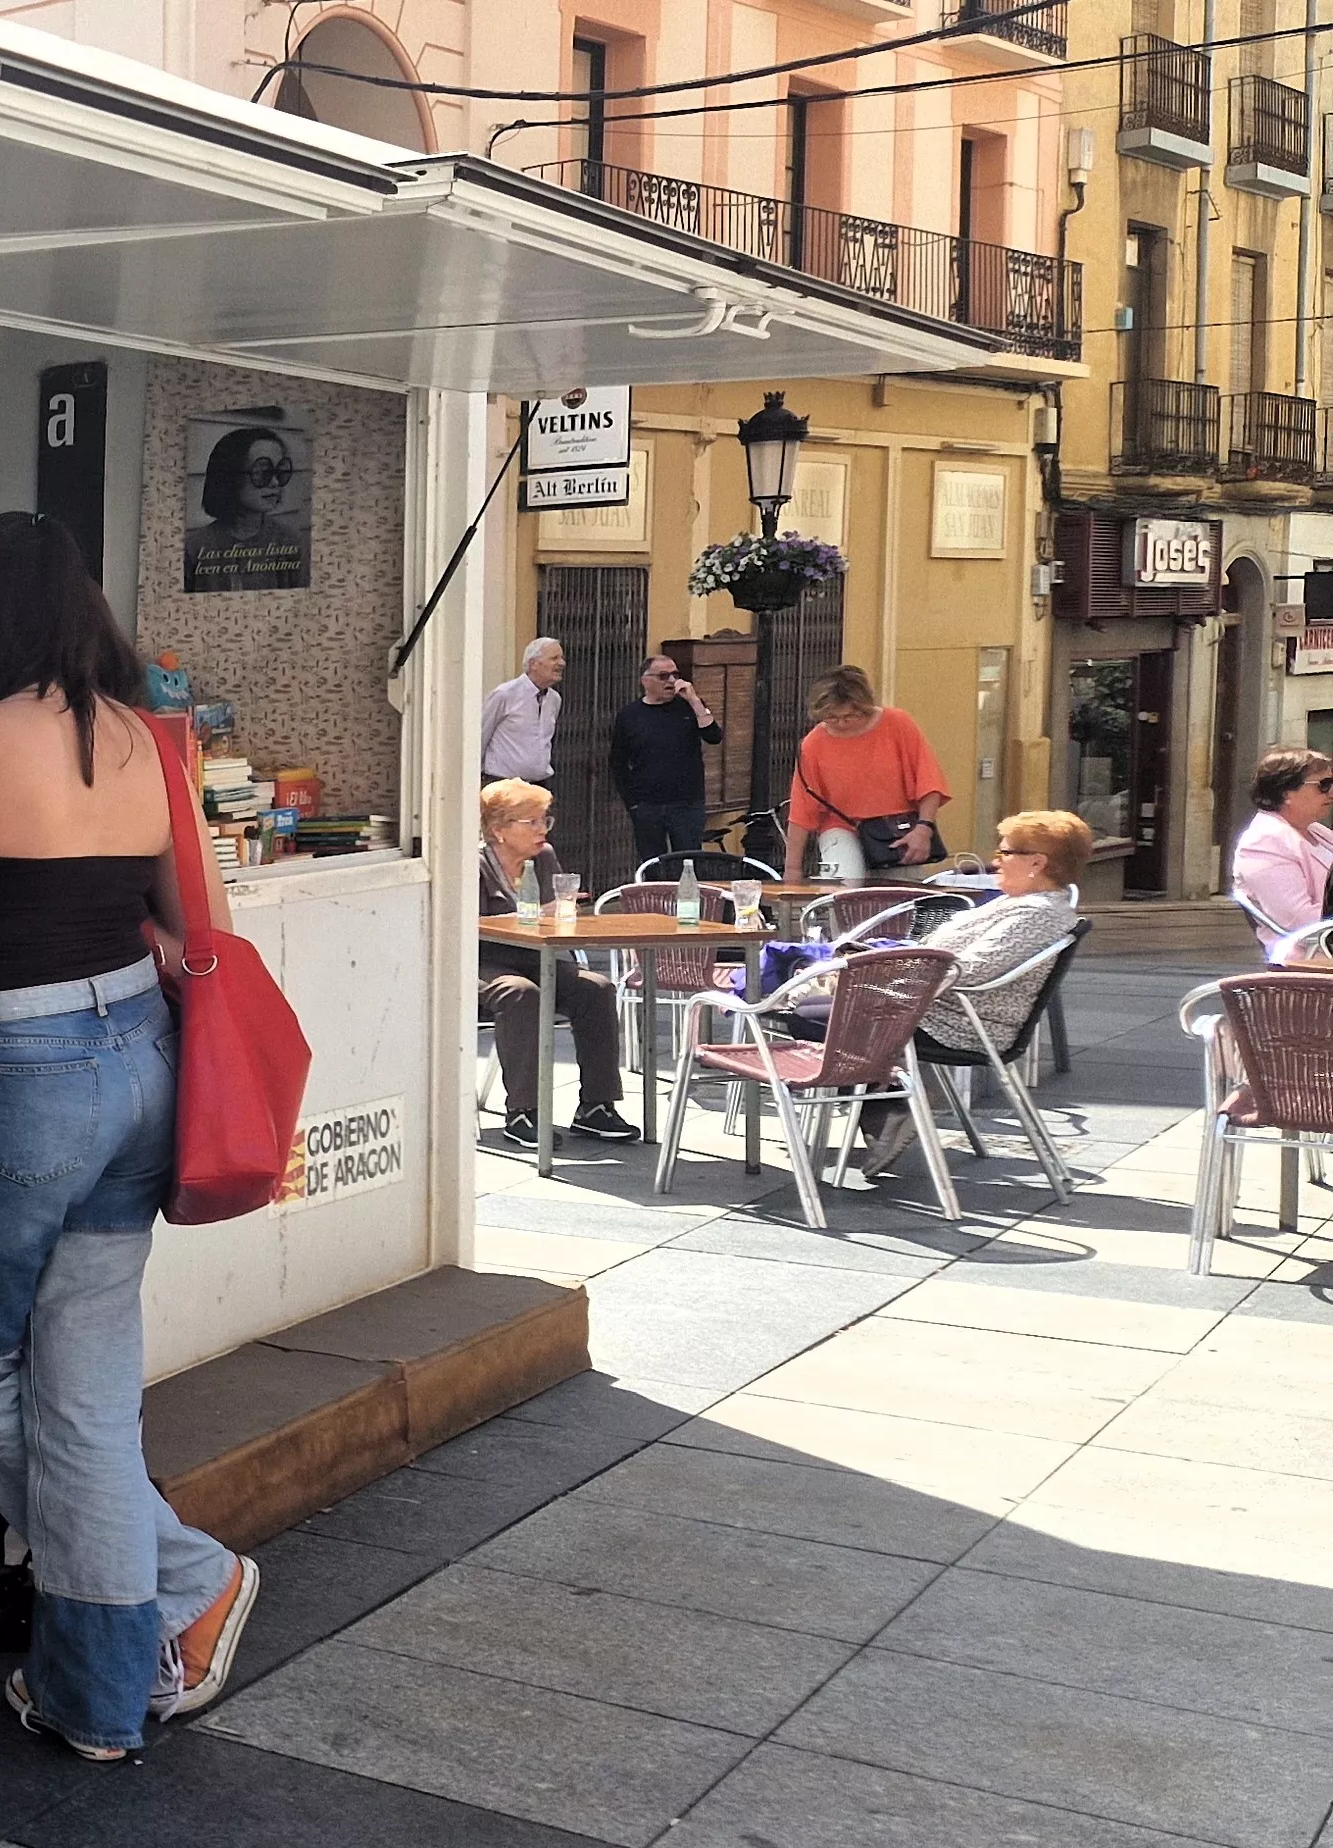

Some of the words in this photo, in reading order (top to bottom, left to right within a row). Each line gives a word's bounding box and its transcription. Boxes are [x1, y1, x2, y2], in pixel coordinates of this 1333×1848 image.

[47, 393, 75, 446] a
[538, 411, 614, 434] VELTINS
[533, 481, 557, 498] Alt
[197, 547, 221, 560] Las
[223, 544, 263, 558] chicas
[266, 542, 298, 555] listas
[194, 561, 221, 575] leen
[223, 564, 238, 574] en
[307, 1109, 391, 1157] GOBIERNO
[307, 1162, 329, 1196] DE
